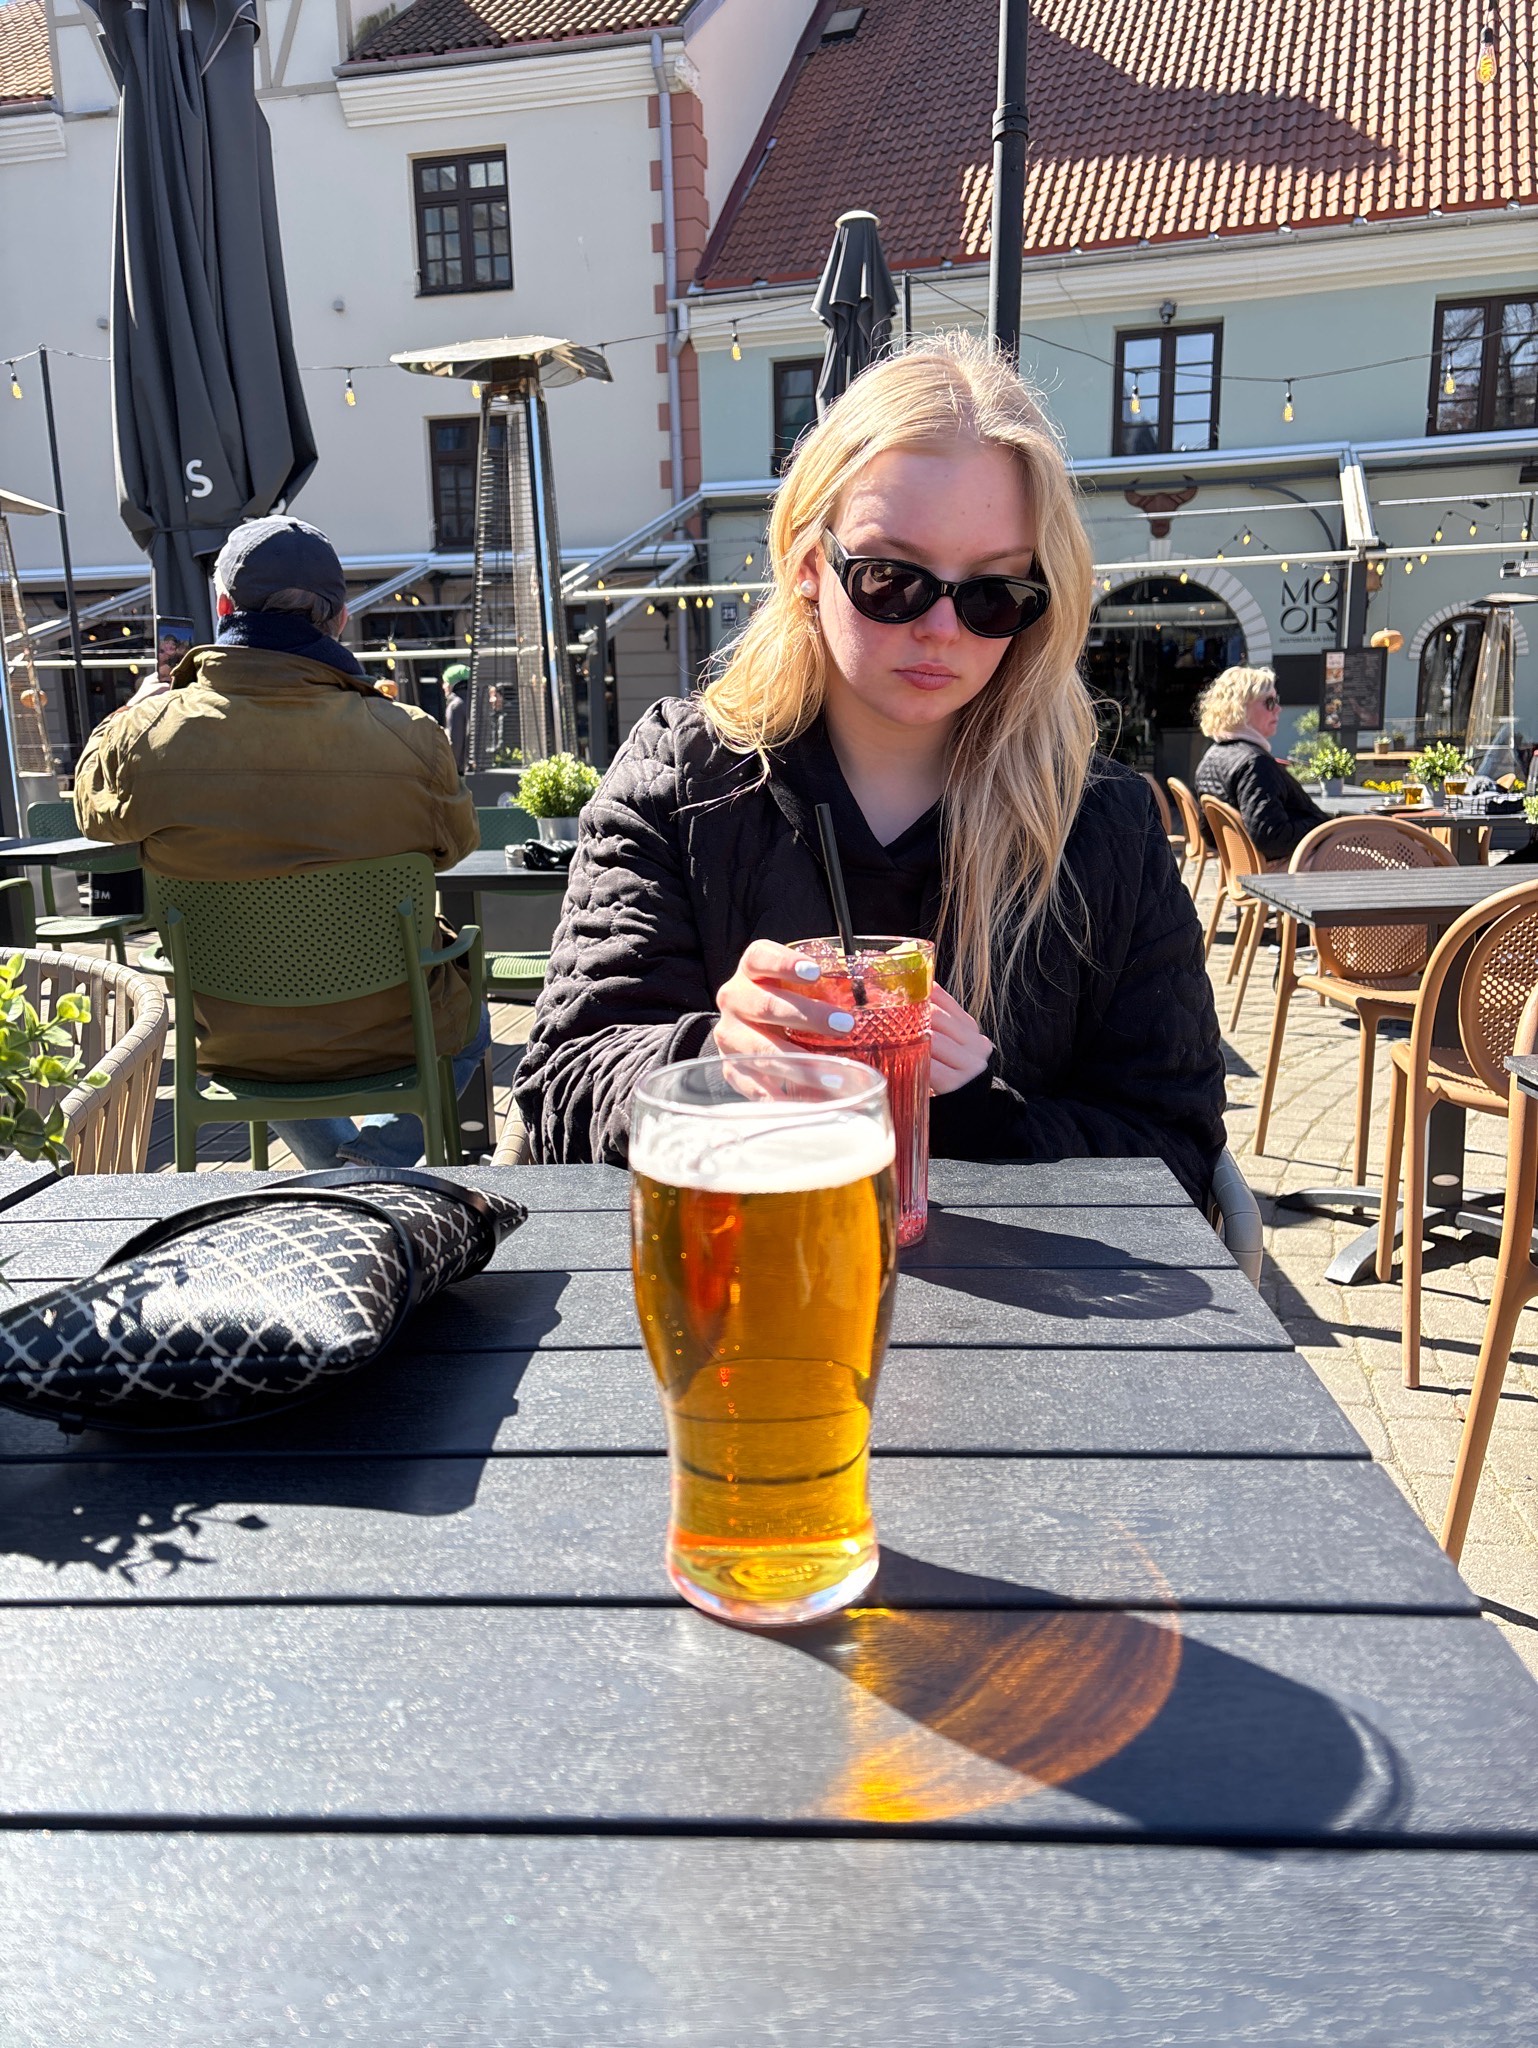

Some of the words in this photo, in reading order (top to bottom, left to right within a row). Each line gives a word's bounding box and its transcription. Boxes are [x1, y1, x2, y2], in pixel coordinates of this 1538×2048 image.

[185, 459, 213, 503] S
[1281, 577, 1339, 606] MO
[1280, 606, 1337, 634] OR
